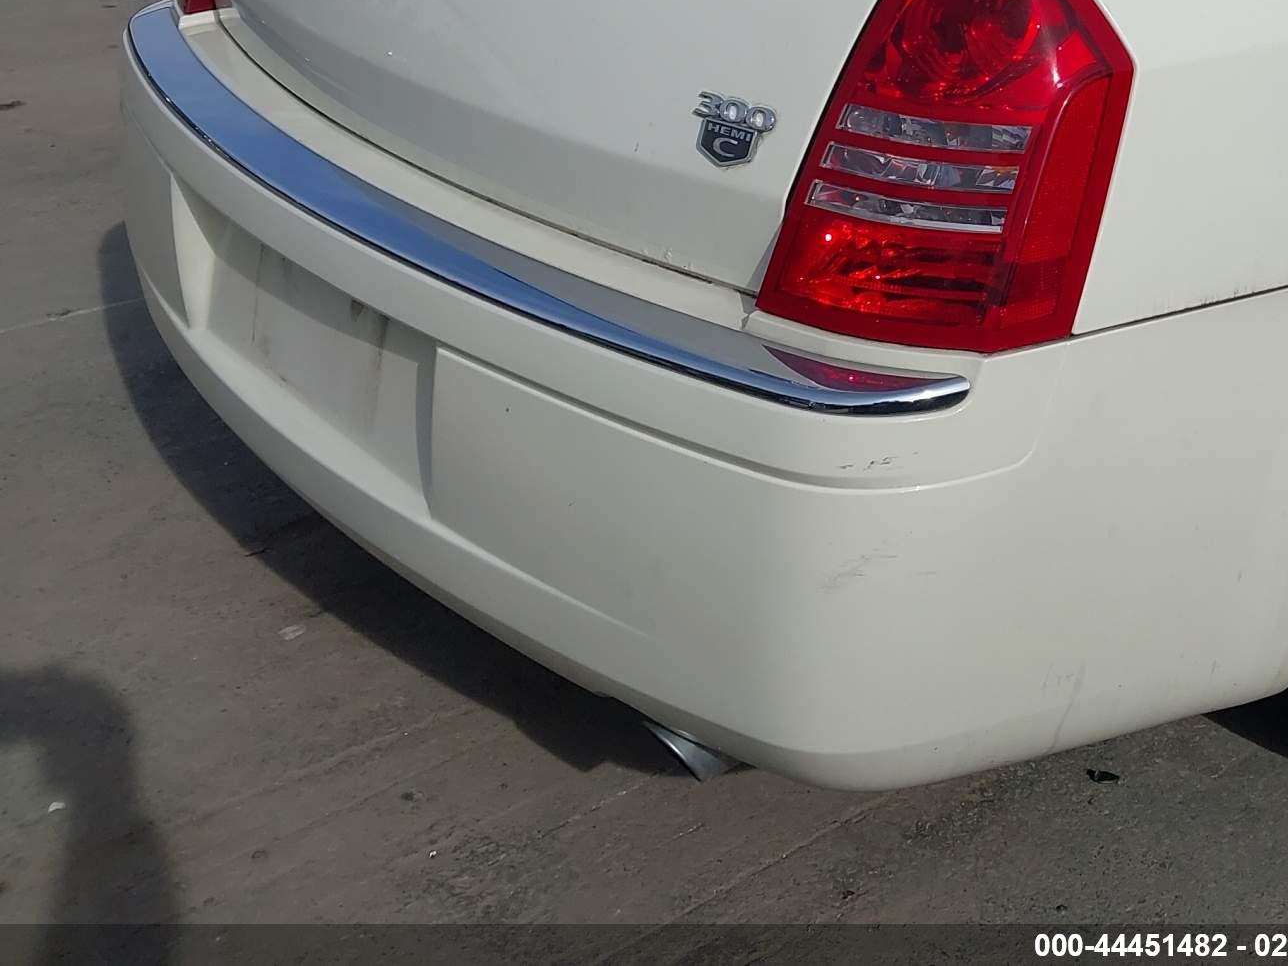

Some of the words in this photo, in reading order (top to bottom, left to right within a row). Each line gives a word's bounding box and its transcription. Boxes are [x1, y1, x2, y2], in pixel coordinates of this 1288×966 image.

[691, 90, 778, 133] 300
[707, 122, 753, 142] HEMI
[712, 137, 739, 158] C
